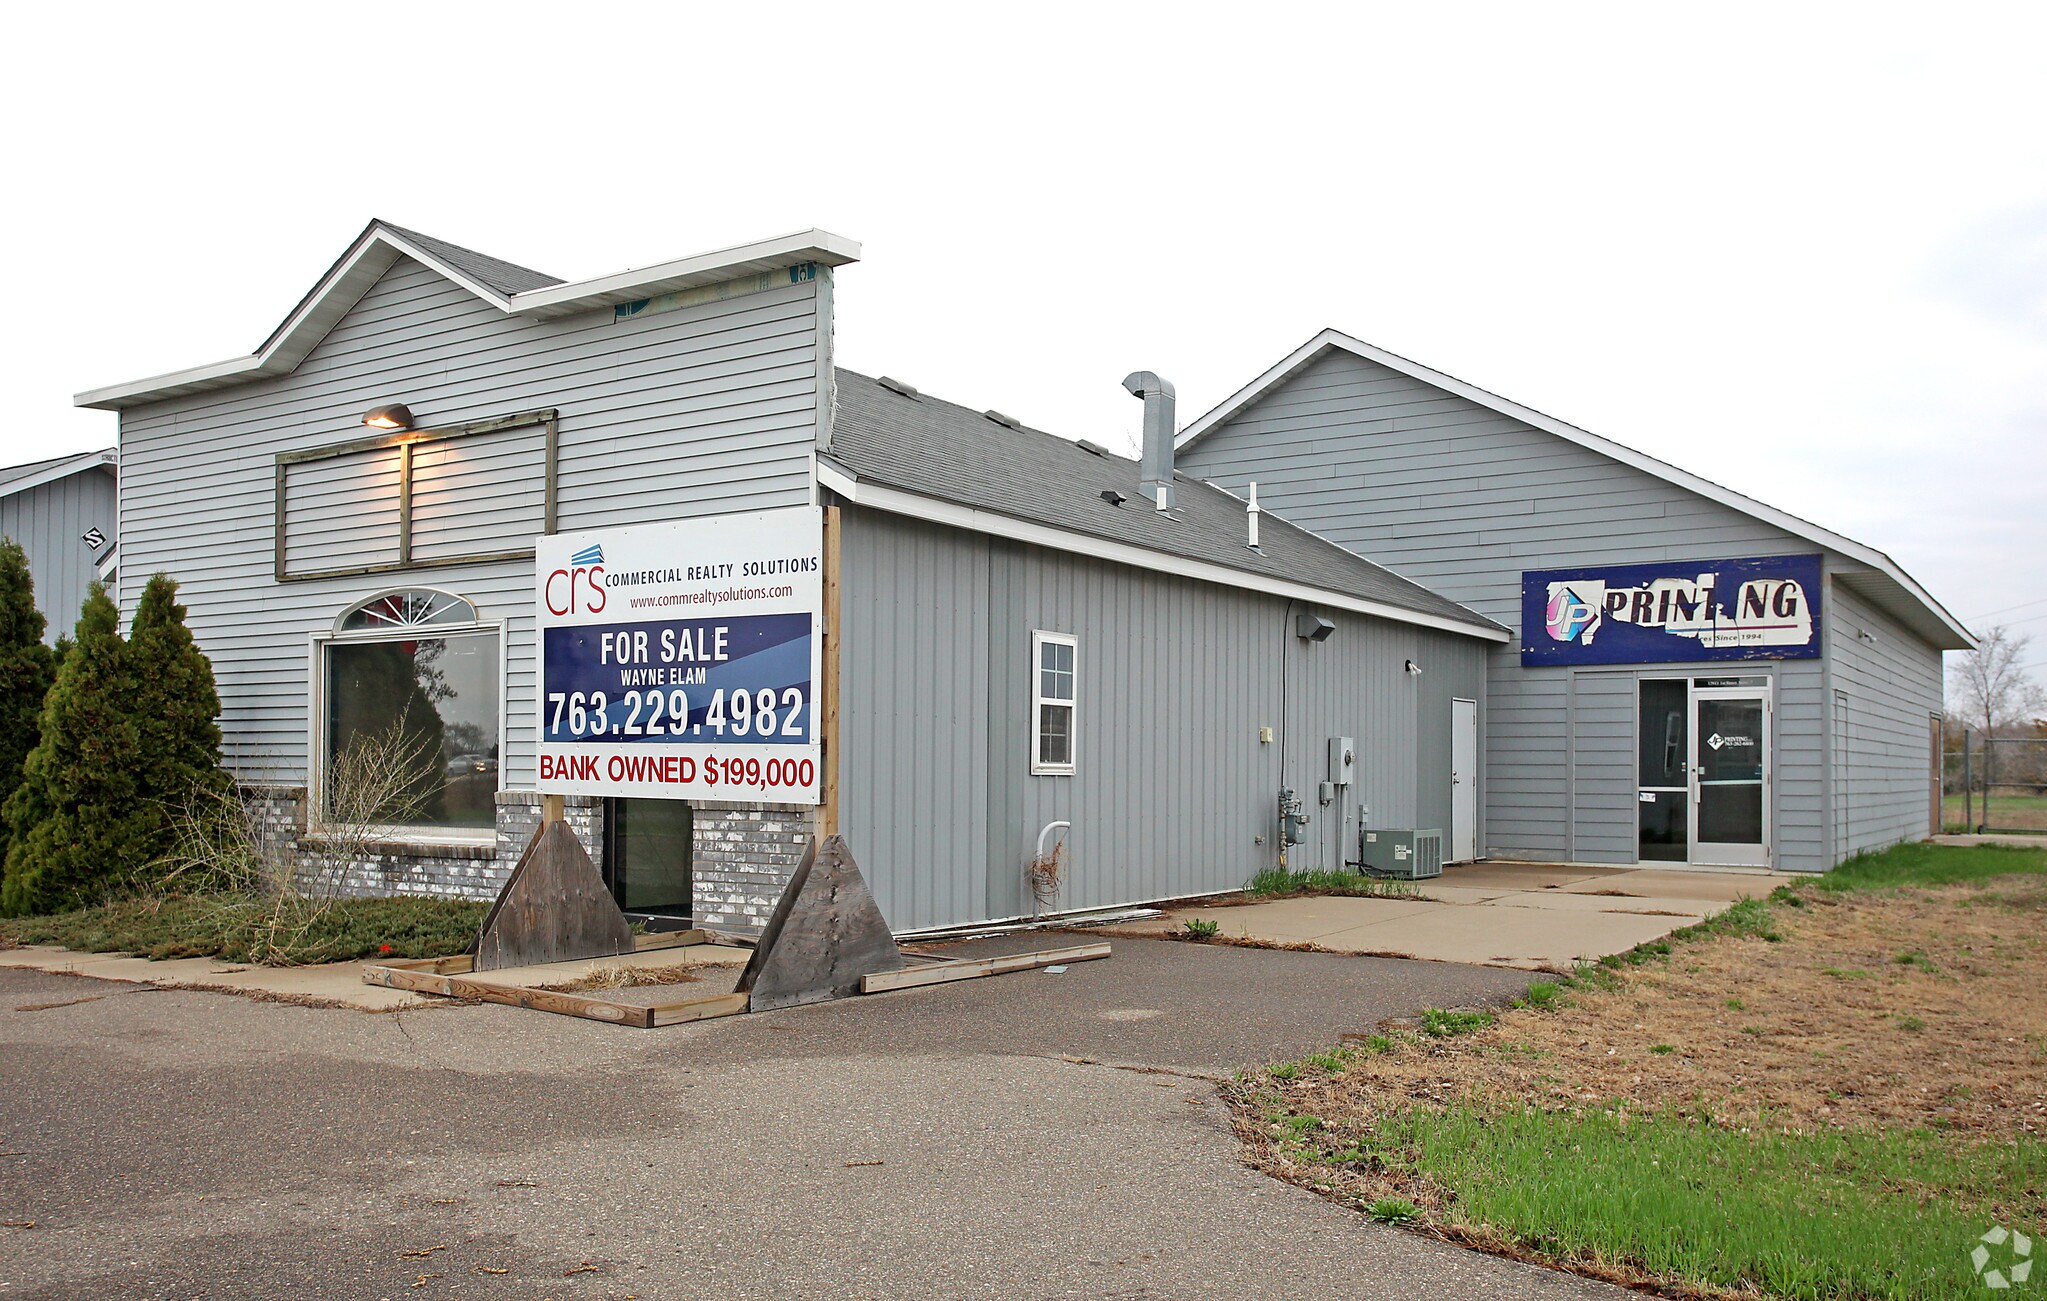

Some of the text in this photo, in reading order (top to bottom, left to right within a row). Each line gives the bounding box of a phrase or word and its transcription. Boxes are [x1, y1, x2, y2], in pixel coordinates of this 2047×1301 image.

[605, 556, 818, 588] COMMERCIAL REALTY SOLUTIONS
[630, 585, 793, 609] www.commrealtysolutions.com
[1605, 582, 1798, 623] PRINTNG
[601, 626, 729, 665] FOR SALE
[620, 666, 706, 687] WAYNE ELAM
[548, 687, 803, 736] 763.229.4982
[540, 753, 814, 791] BANK OWNED $199,000
